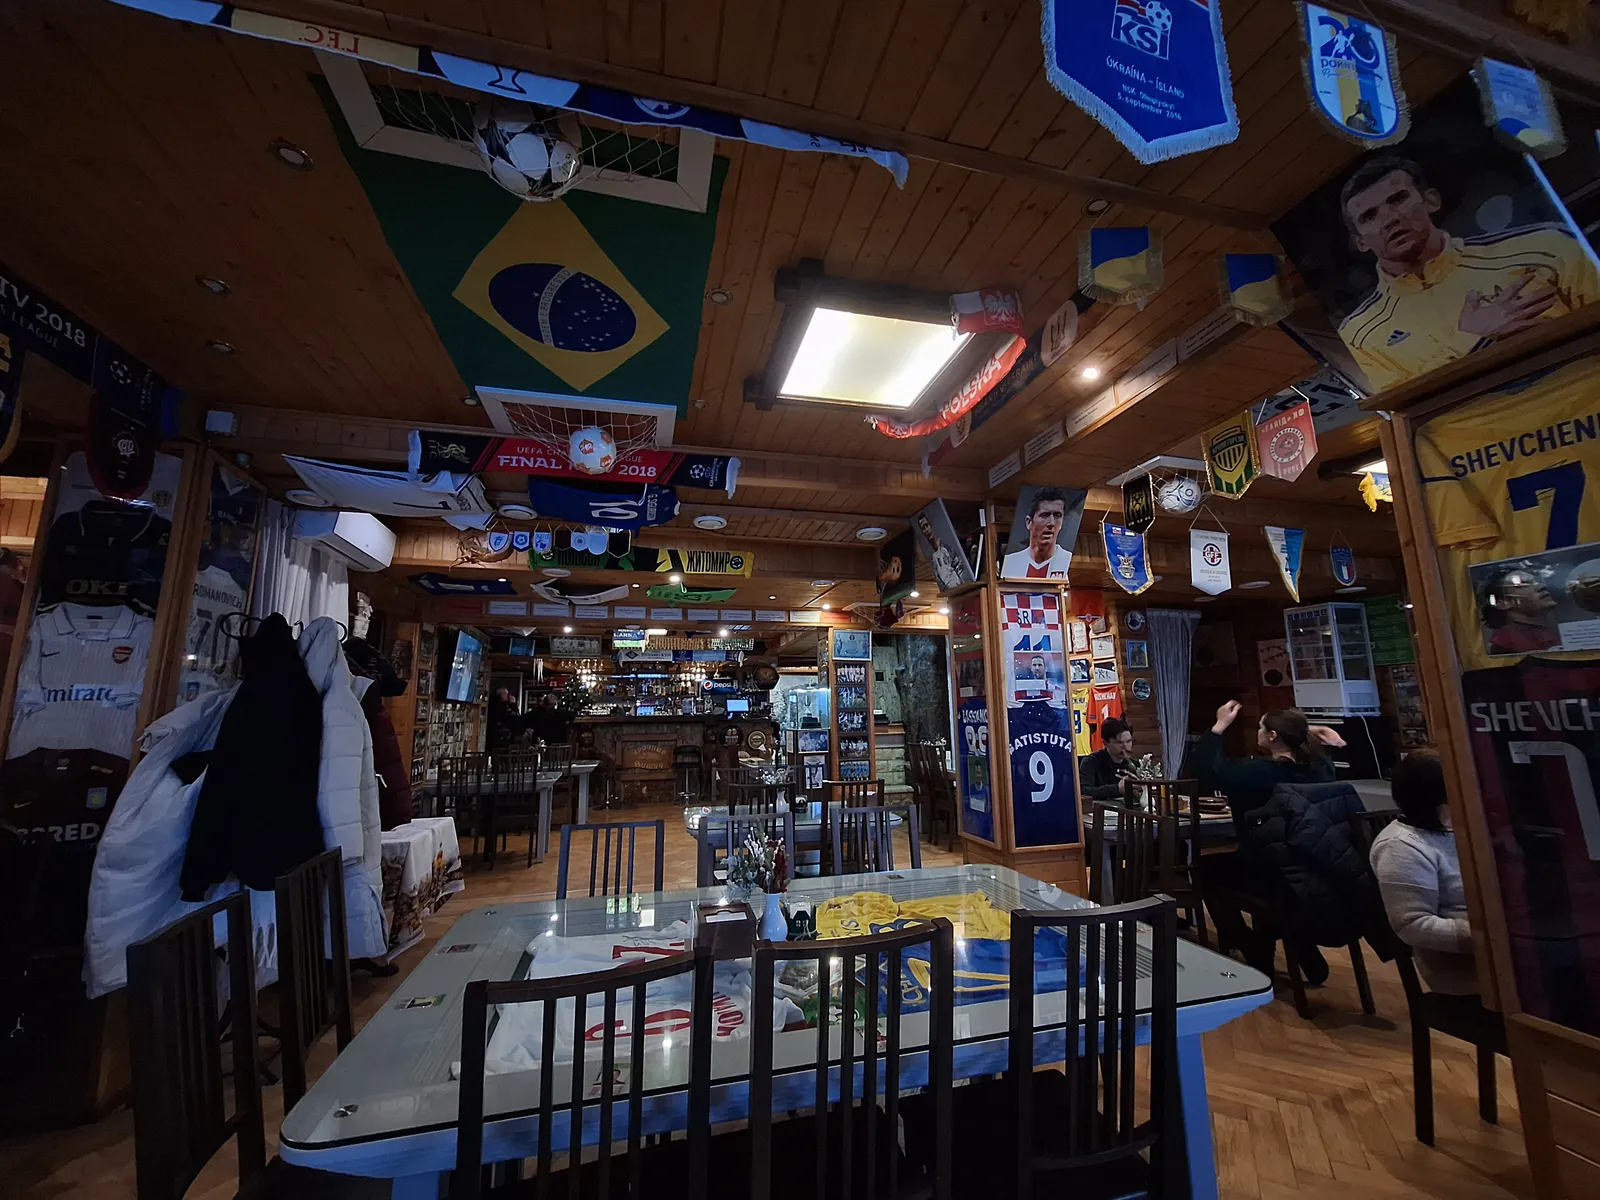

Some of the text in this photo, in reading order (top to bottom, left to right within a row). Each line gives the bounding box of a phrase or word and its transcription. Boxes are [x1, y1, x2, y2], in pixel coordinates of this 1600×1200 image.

[1106, 55, 1146, 84] ÚKRAÍNA
[1155, 76, 1185, 99] ÍSLAND
[36, 302, 86, 348] 2018
[497, 455, 563, 470] FINAL
[618, 464, 657, 478] 2018
[516, 446, 543, 455] UEFA
[1451, 412, 1600, 478] SHEVCHEN
[1506, 460, 1586, 551] 7
[686, 550, 731, 573] ЖИТОМИР
[65, 579, 128, 596] OKI
[713, 681, 732, 689] pepsi
[1029, 750, 1054, 803] 9
[1508, 740, 1600, 861] 7
